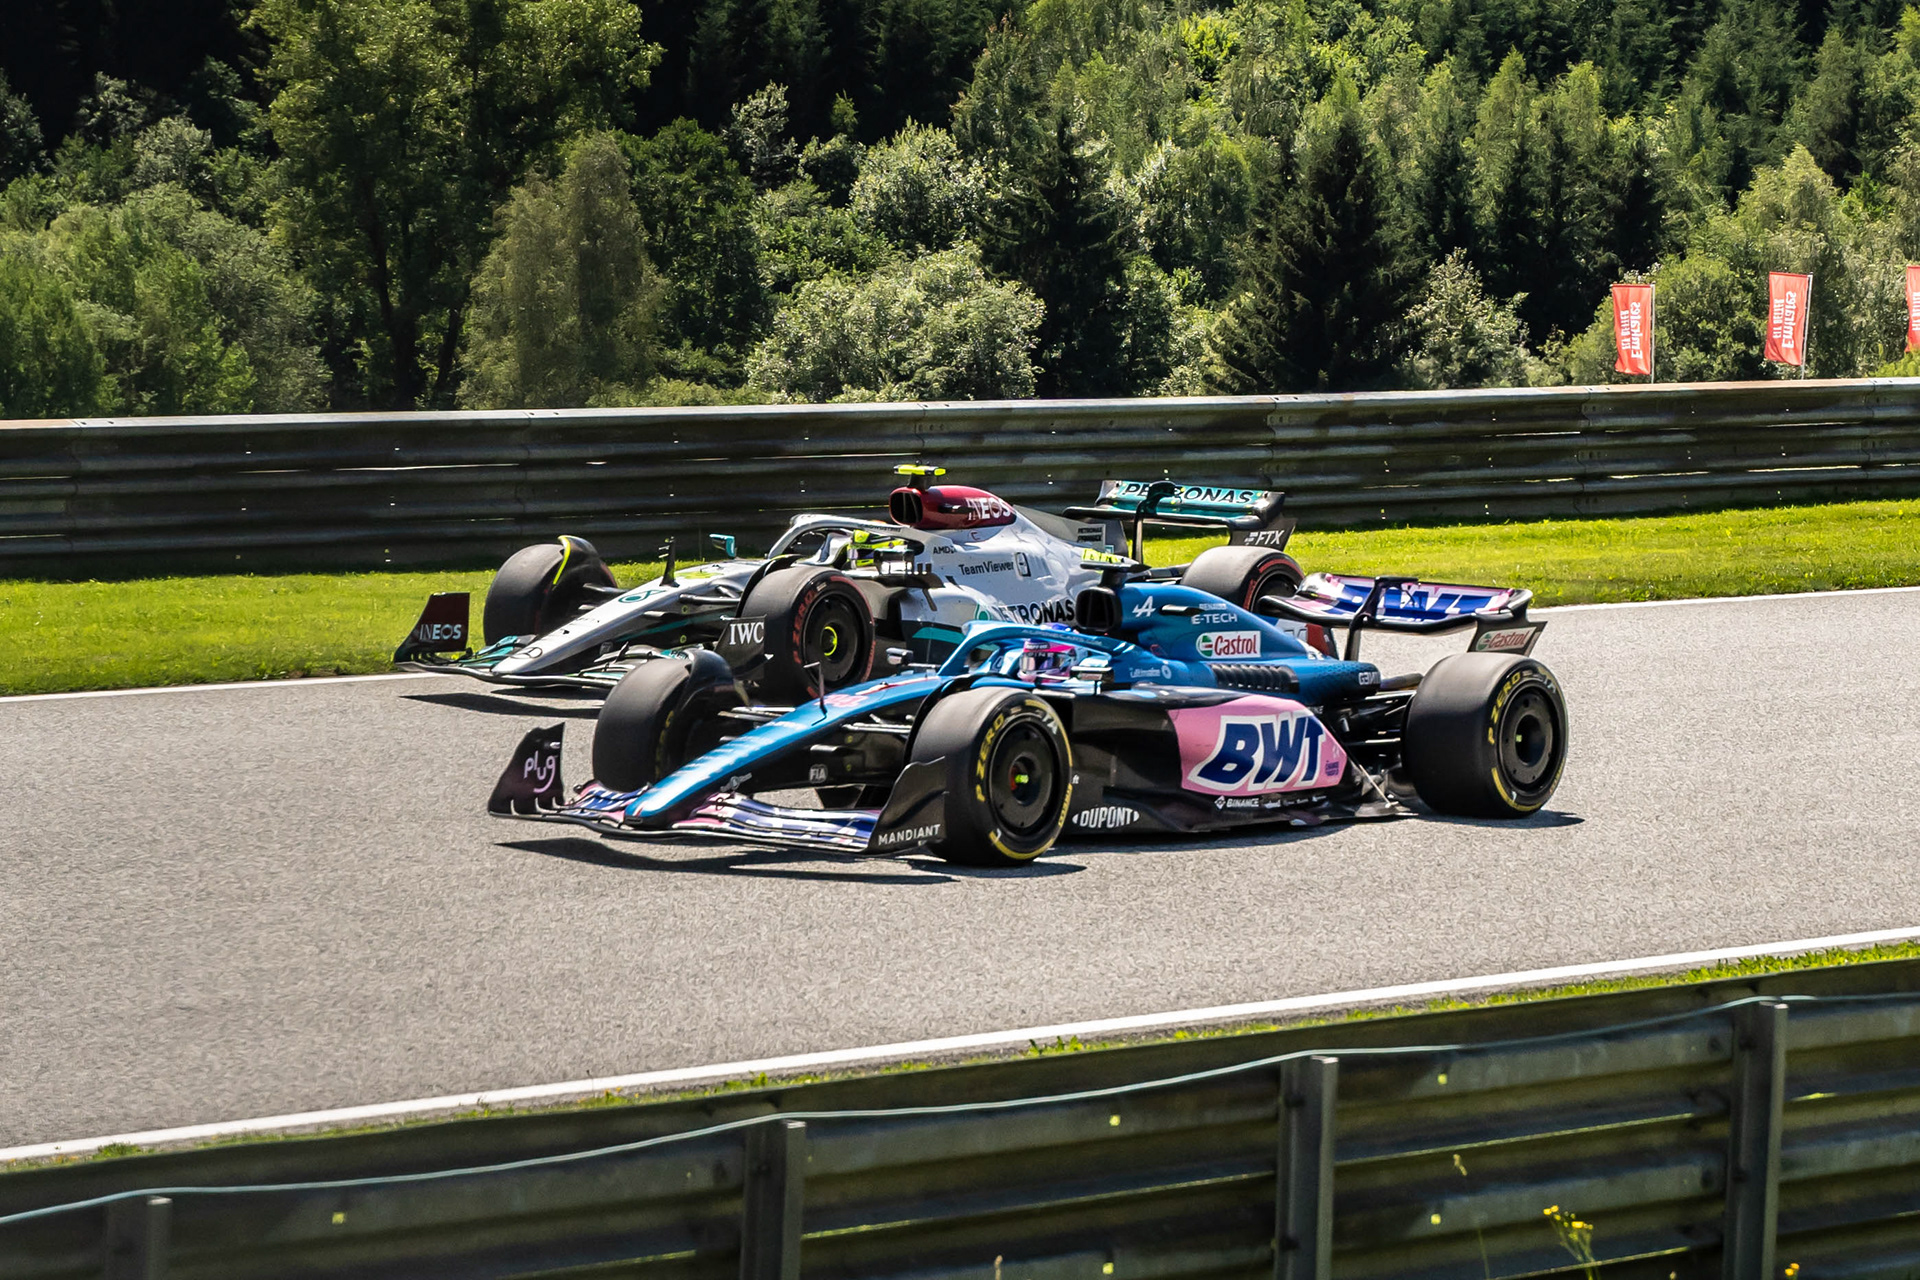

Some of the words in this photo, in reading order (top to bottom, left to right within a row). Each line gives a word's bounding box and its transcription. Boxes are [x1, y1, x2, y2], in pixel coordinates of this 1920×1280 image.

[1124, 482, 1254, 504] PERONAS
[965, 497, 1011, 520] INEOS
[1255, 530, 1285, 545] FTX
[933, 545, 952, 554] AMD
[958, 561, 1014, 575] TeamViewer
[1191, 613, 1238, 625] E-TECH
[419, 624, 463, 640] INEOS
[729, 621, 765, 645] IWC
[1488, 630, 1530, 648] Castrol
[1214, 633, 1258, 656] Castrol
[1490, 672, 1521, 724] ZERO
[976, 713, 1005, 780] ZERO
[1192, 712, 1326, 789] BWT
[524, 750, 557, 793] plug
[809, 767, 826, 781] FIA
[1226, 797, 1260, 808] BINANCE
[1079, 806, 1133, 829] DUPONT
[878, 823, 941, 846] MANDIANT
